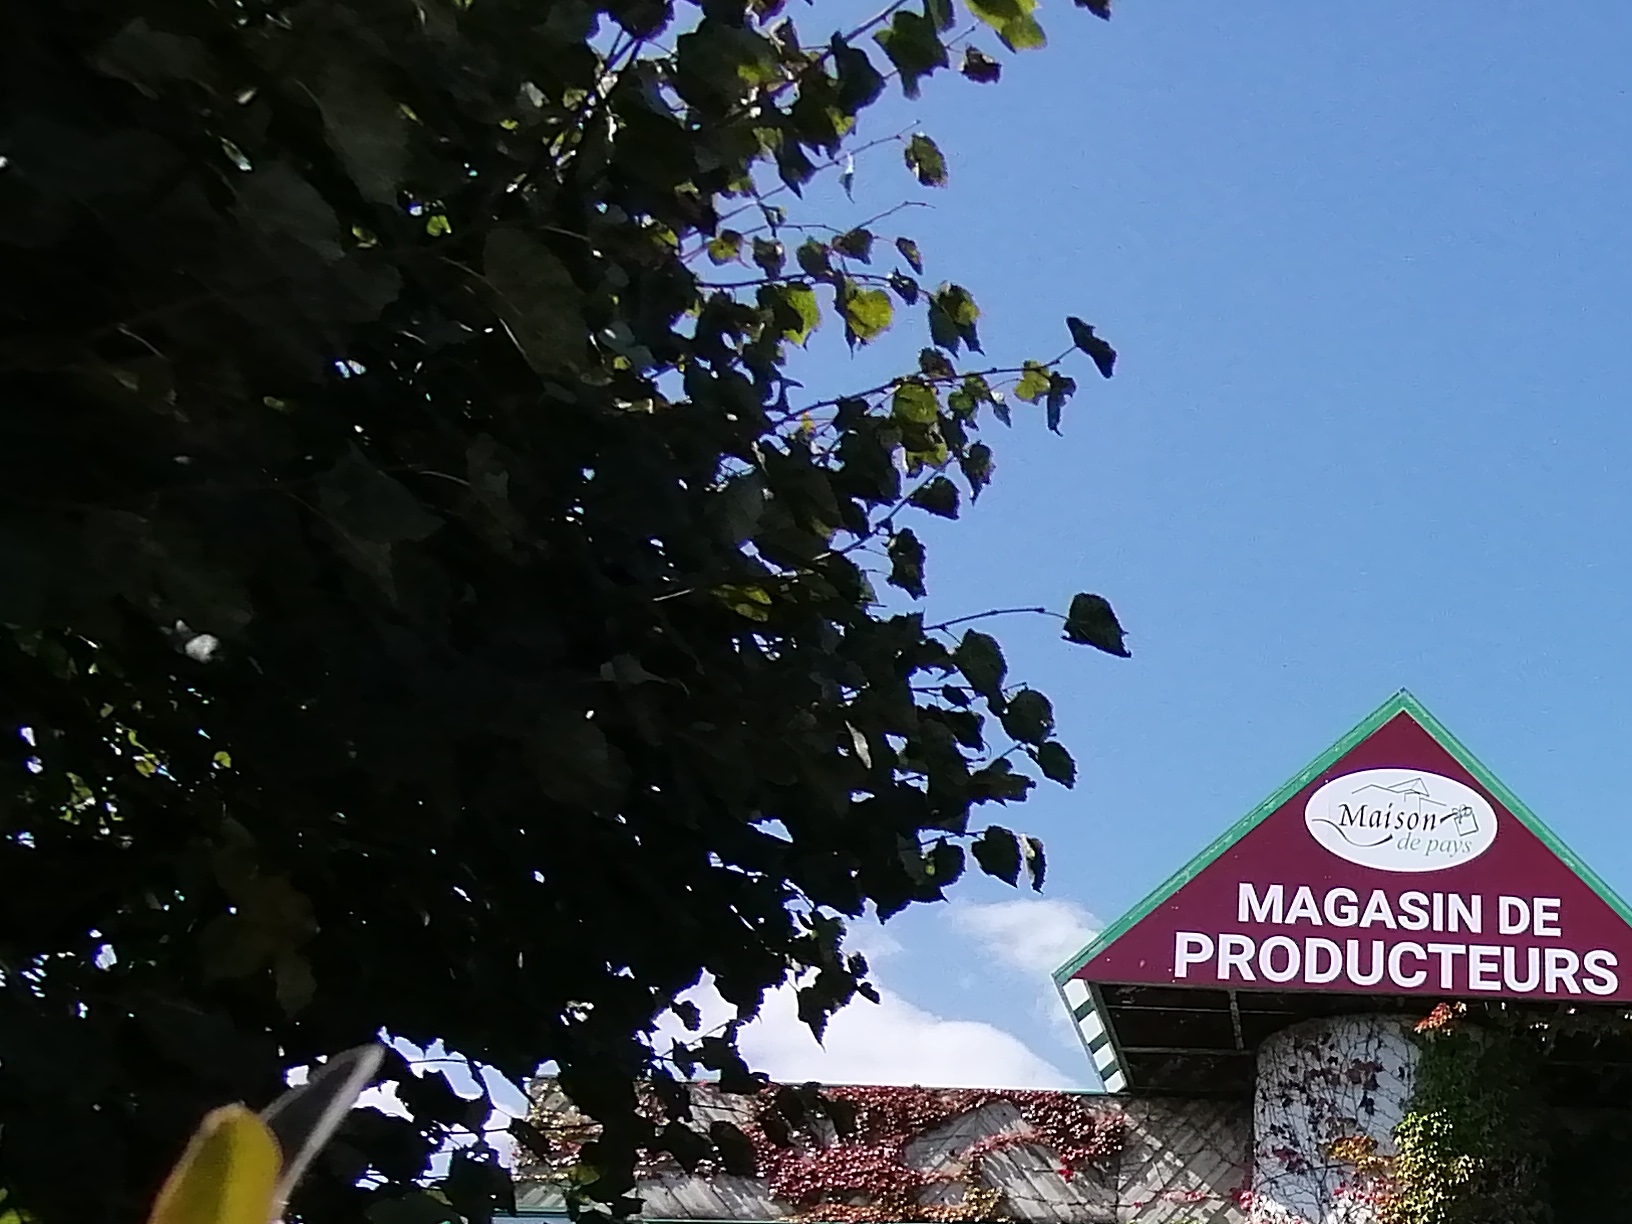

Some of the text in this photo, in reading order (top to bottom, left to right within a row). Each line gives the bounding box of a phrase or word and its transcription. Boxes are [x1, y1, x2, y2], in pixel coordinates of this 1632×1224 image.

[1338, 802, 1437, 832] Maison
[1397, 832, 1473, 858] de pays
[1237, 882, 1562, 938] MAGASIN DE
[1173, 931, 1620, 996] PRODUCTEURS
